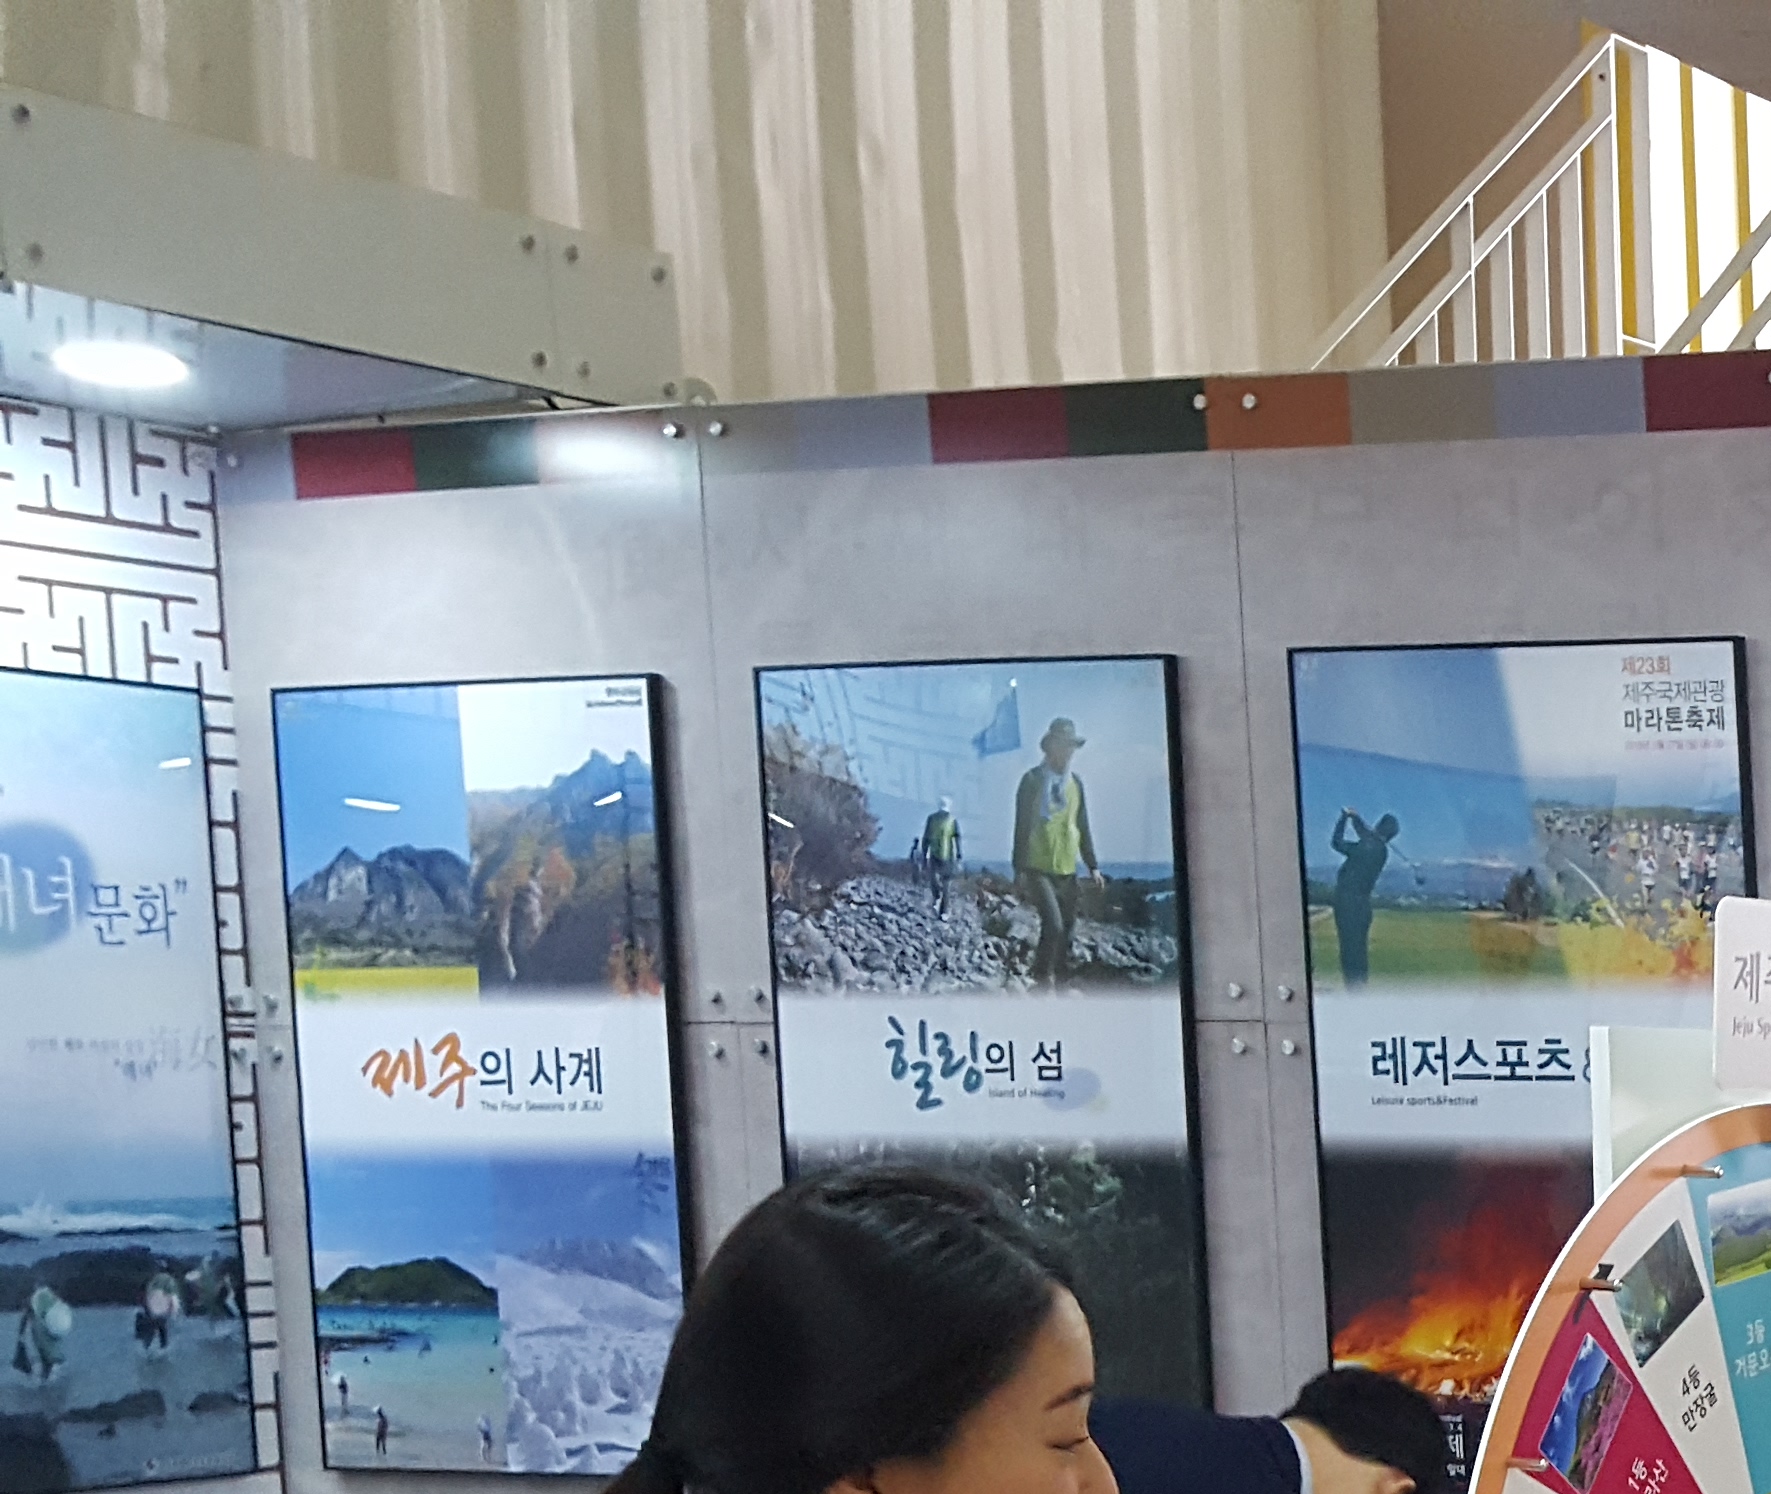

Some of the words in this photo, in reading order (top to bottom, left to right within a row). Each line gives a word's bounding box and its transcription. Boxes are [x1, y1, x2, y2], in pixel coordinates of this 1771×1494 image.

[1621, 655, 1671, 675] 제23회
[1622, 680, 1725, 703] 제주국제관광
[1623, 705, 1725, 732] 마라톤축제
[1732, 1016, 1754, 1037] Jeju
[362, 1031, 518, 1110] 제주의
[529, 1047, 604, 1097] 사계
[884, 1016, 1015, 1111] 힐링의
[1030, 1038, 1064, 1085] 섬
[1370, 1035, 1577, 1087] 레저스포츠
[1680, 1362, 1702, 1398] 4등
[1681, 1381, 1719, 1432] 만장굴
[1628, 1456, 1650, 1493] 1등
